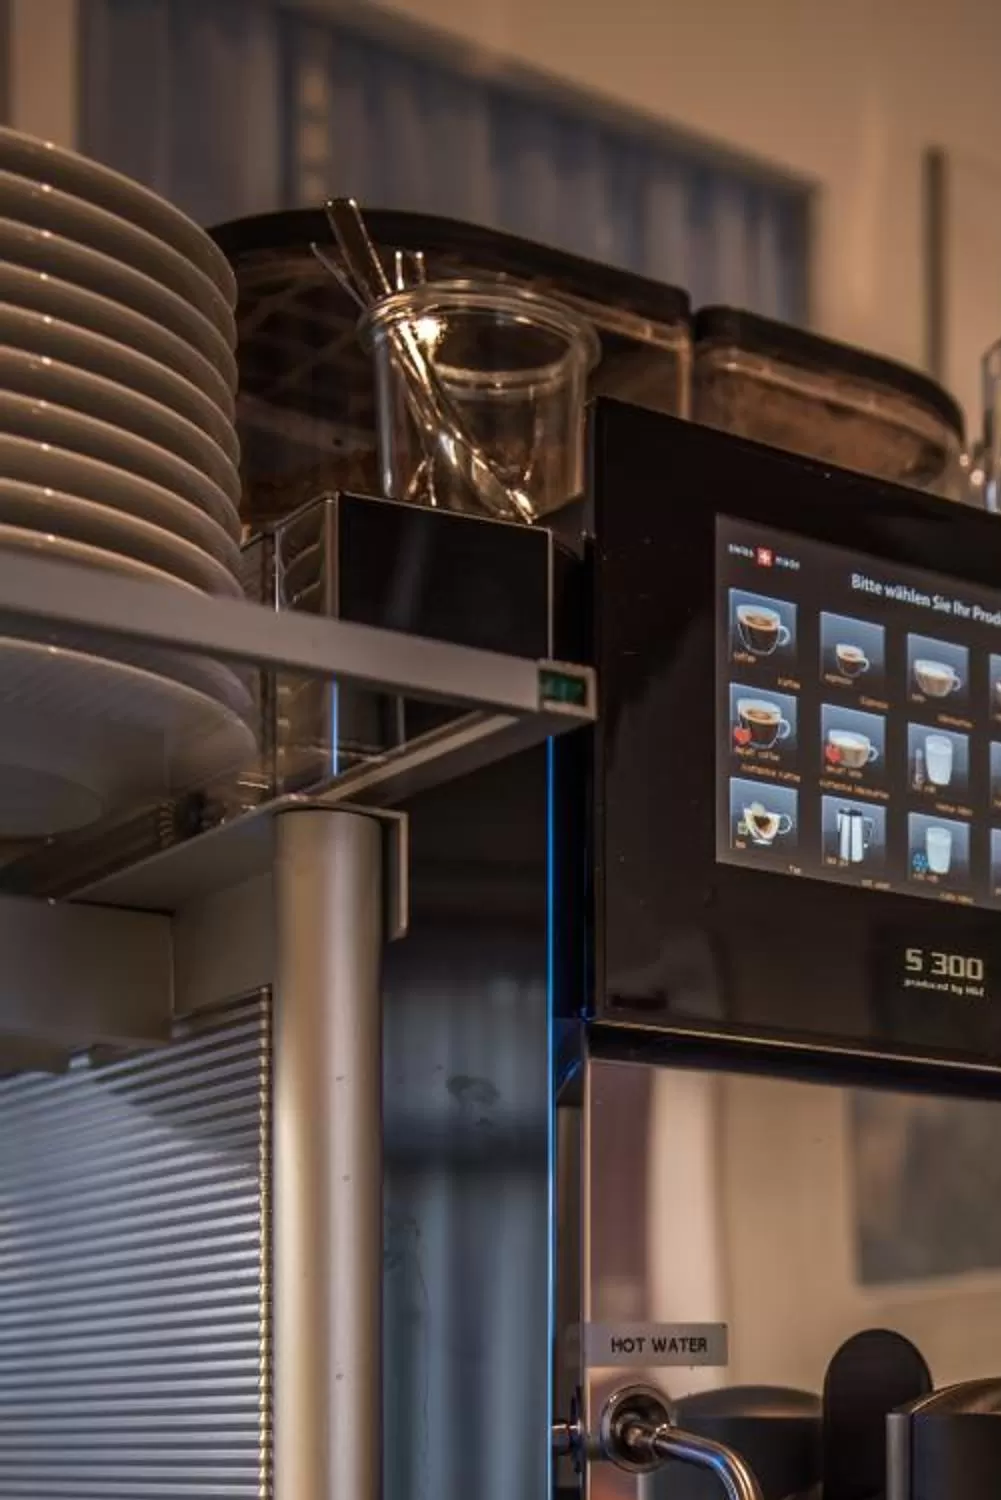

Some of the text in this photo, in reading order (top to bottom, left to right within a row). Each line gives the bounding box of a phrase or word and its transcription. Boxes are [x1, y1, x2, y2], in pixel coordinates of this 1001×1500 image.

[851, 573, 882, 595] Bitte
[885, 585, 931, 608] wählen
[932, 594, 950, 614] Sie
[953, 600, 971, 618] Ihr
[905, 948, 983, 980] S 300
[611, 1336, 708, 1353] HOT WATER
